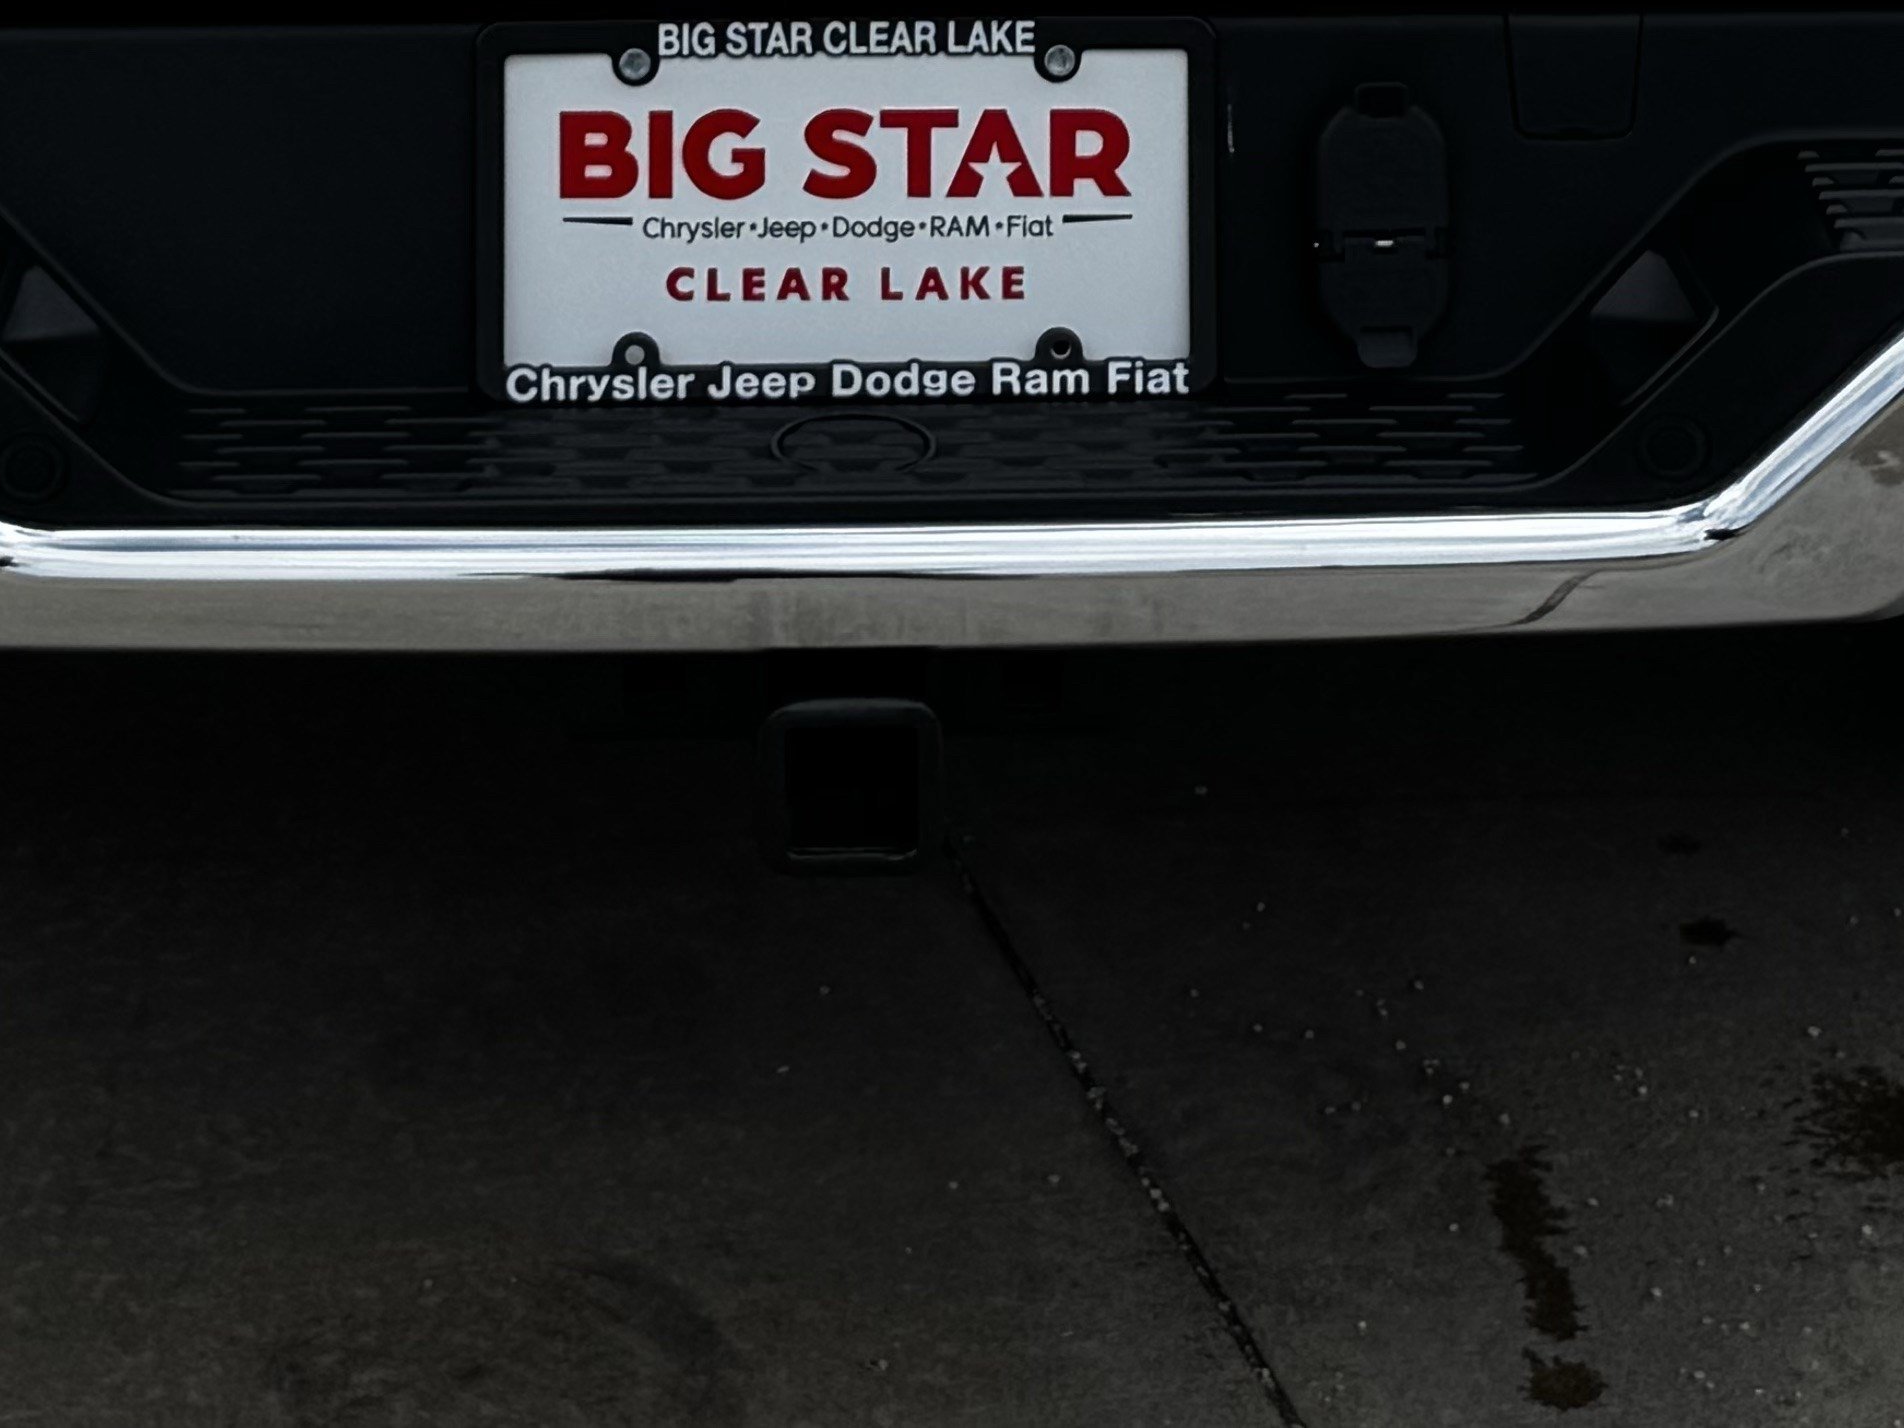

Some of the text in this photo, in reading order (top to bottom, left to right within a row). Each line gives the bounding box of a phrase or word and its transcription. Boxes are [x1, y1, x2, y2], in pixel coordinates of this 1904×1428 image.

[658, 20, 1036, 56] BIG STAR CLEAR LAKE
[558, 107, 1132, 200] BIG STAR
[642, 214, 1054, 243] Chrysler Jeep Dodge RAM Fiat
[665, 265, 1027, 301] CLEAR LAKE
[506, 360, 1190, 402] Chrysler Jeep Dodge Ram Fiat
